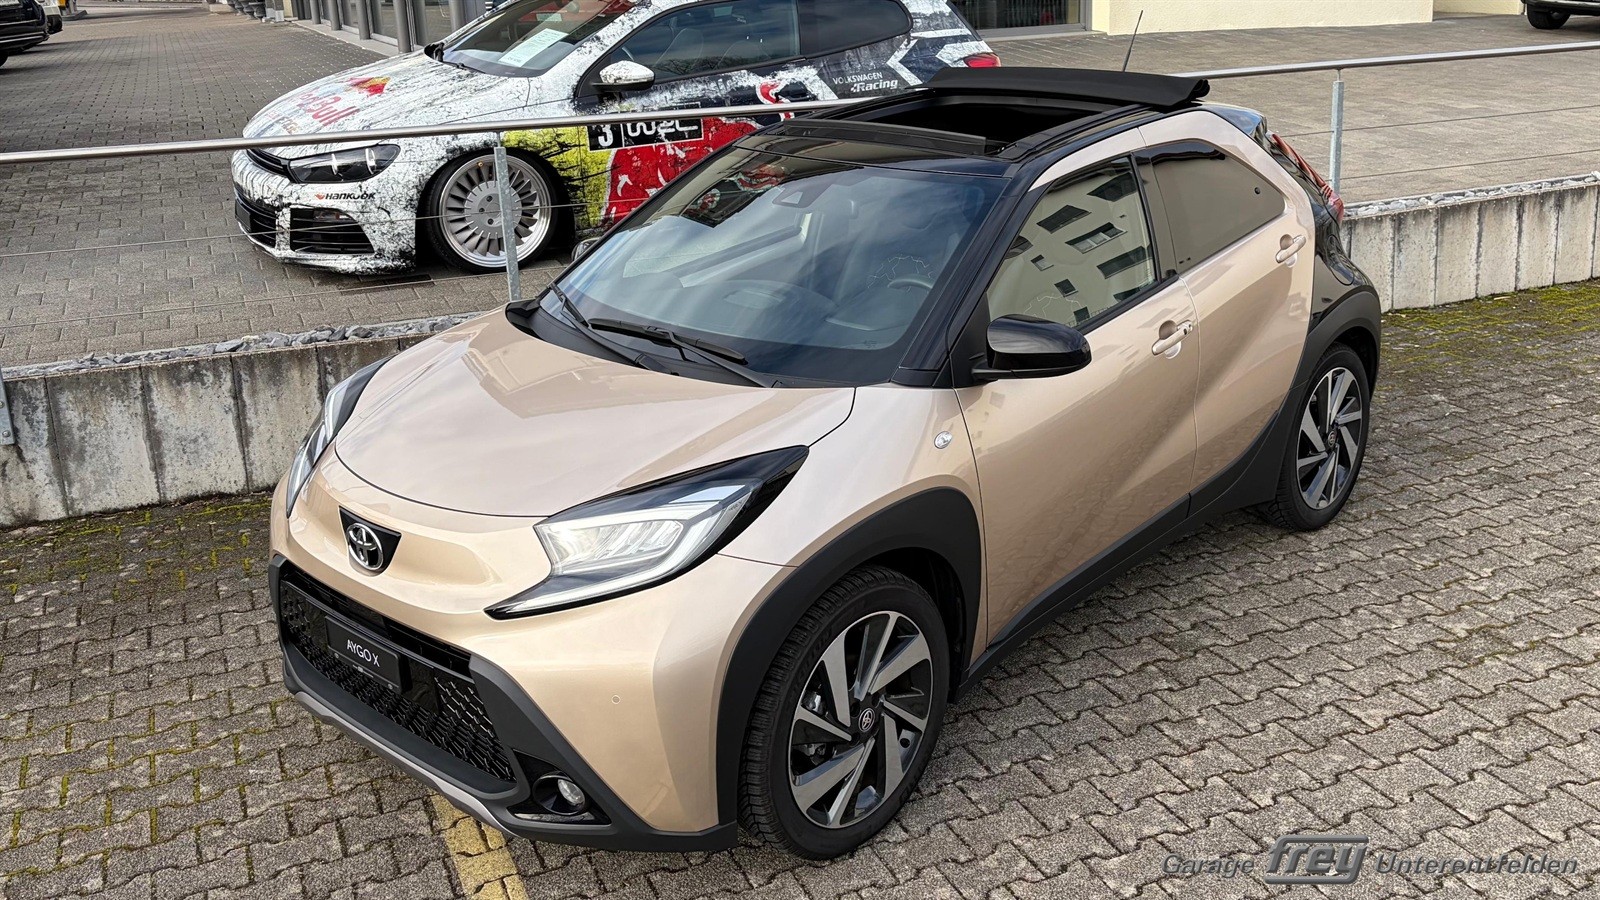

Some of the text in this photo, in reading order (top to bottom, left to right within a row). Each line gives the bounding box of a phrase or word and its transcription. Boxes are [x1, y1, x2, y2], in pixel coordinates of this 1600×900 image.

[832, 72, 883, 85] VOLKSWAGEN
[855, 79, 899, 92] Racing
[346, 639, 380, 667] AYGO X
